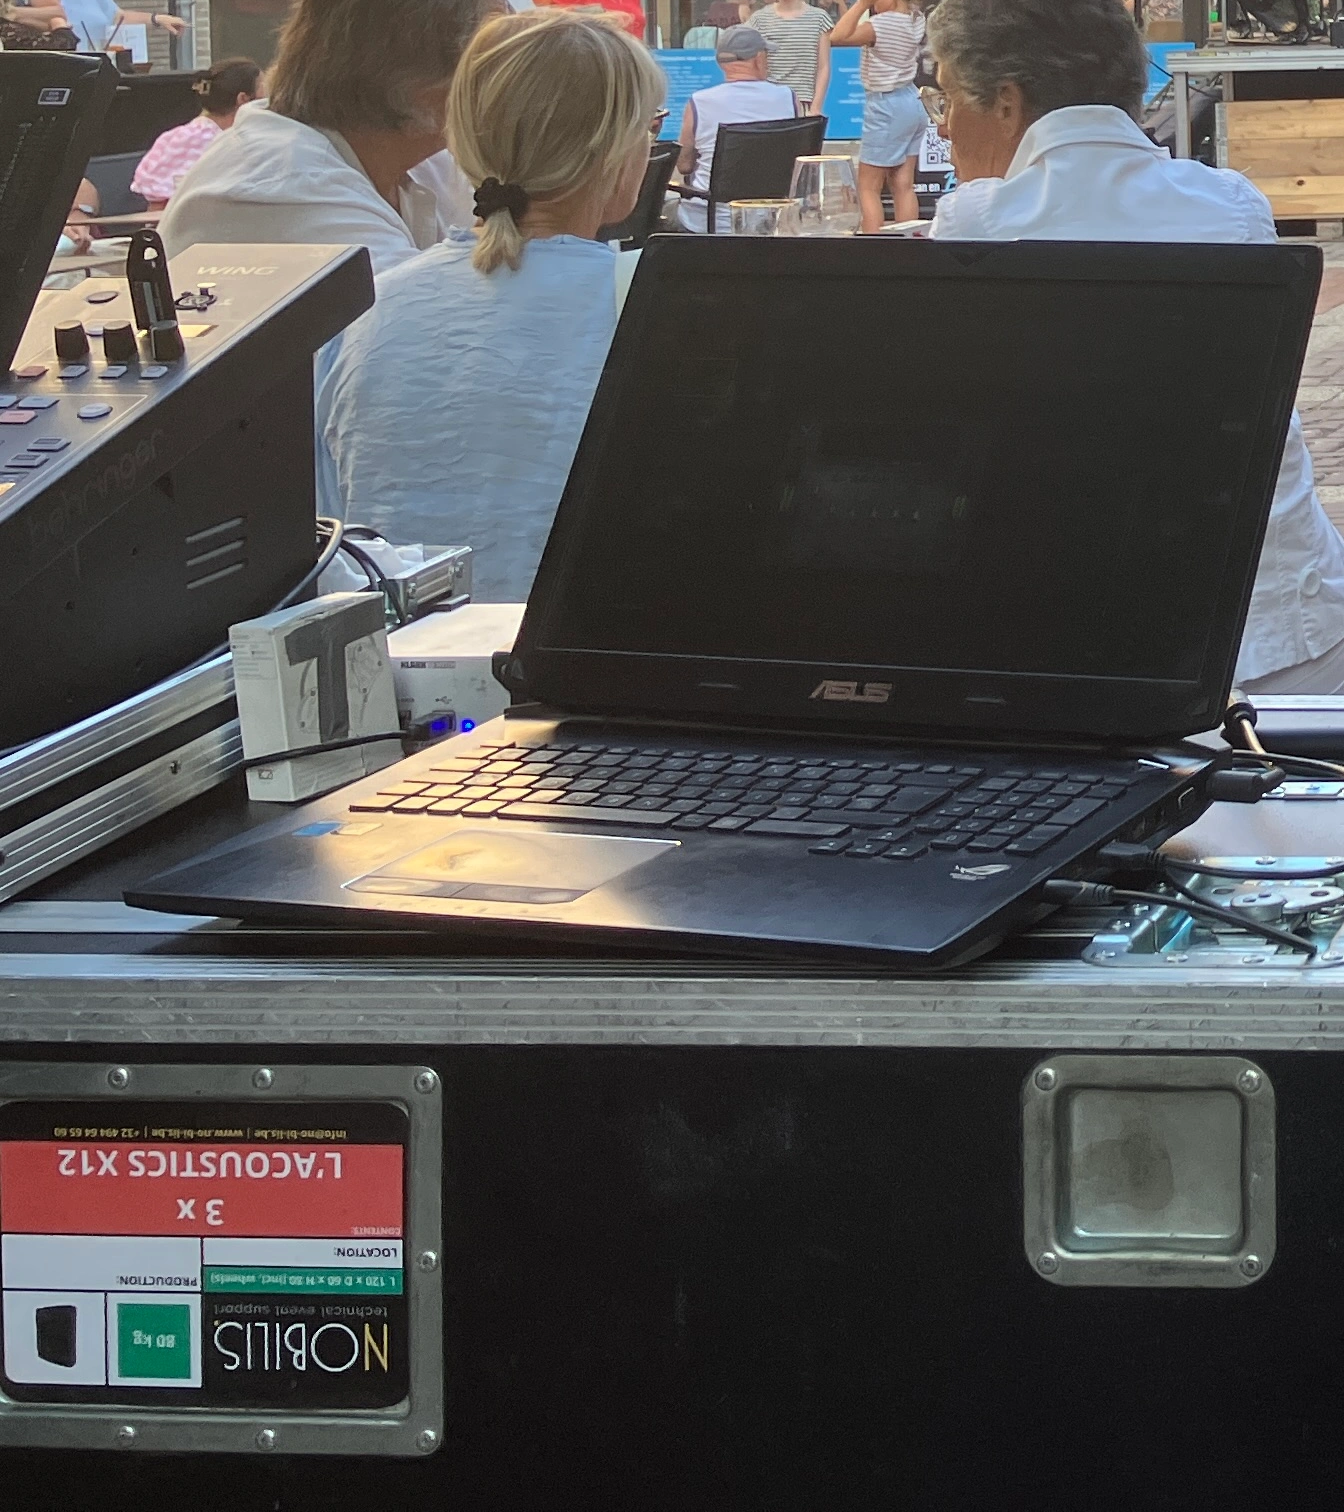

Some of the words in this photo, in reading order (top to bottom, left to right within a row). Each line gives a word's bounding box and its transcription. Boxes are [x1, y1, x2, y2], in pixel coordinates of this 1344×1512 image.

[197, 266, 280, 276] WING
[809, 680, 893, 703] ASUS
[57, 1148, 118, 1177] X12
[176, 1198, 195, 1220] x
[205, 1199, 224, 1225] 3
[333, 1246, 398, 1258] LOCATION:
[116, 1275, 198, 1287] PRODUCTION:
[345, 1275, 354, 1286] D
[365, 1275, 386, 1287] 120
[214, 1303, 271, 1316] support
[275, 1305, 315, 1317] event
[321, 1305, 388, 1318] technical
[132, 1330, 153, 1349] kg
